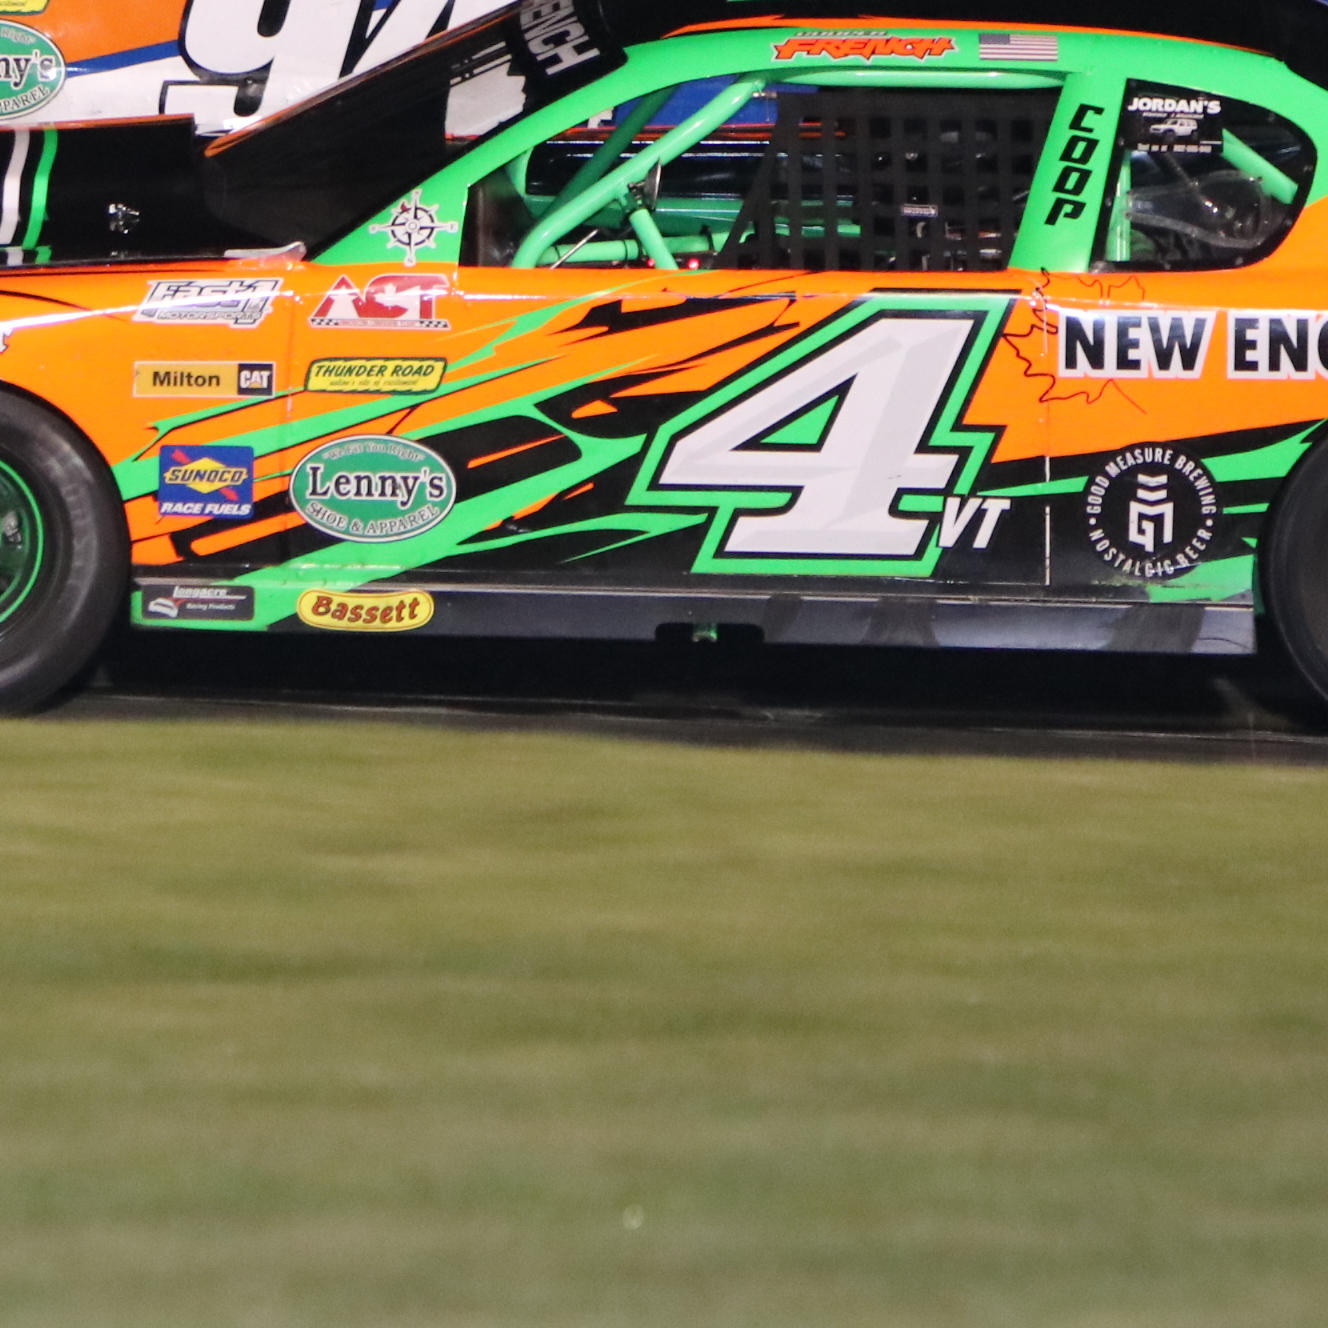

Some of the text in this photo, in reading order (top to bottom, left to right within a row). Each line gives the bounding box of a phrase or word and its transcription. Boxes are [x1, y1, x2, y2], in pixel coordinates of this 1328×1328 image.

[773, 36, 956, 61] FRENCH
[1127, 97, 1221, 114] JORDAN'S
[1045, 104, 1104, 226] COOP
[313, 275, 448, 319] ACT
[157, 311, 262, 320] MOTORSPORTS
[1064, 315, 1209, 373] NEW
[152, 370, 271, 389] Milton CAT
[315, 365, 435, 377] THUNDER ROAD
[366, 441, 386, 452] You
[652, 310, 980, 560] 4
[168, 468, 244, 483] SUNOCO
[308, 465, 445, 507] Lenny's
[1086, 447, 1217, 515] GOOD MEASURE BREWING
[161, 502, 252, 516] RACE FUELS
[307, 501, 440, 535] SHOE & APPAREL
[938, 496, 1011, 549] VT
[1089, 528, 1213, 578] NOSTALGIC BEER
[311, 594, 421, 626] Bassett
